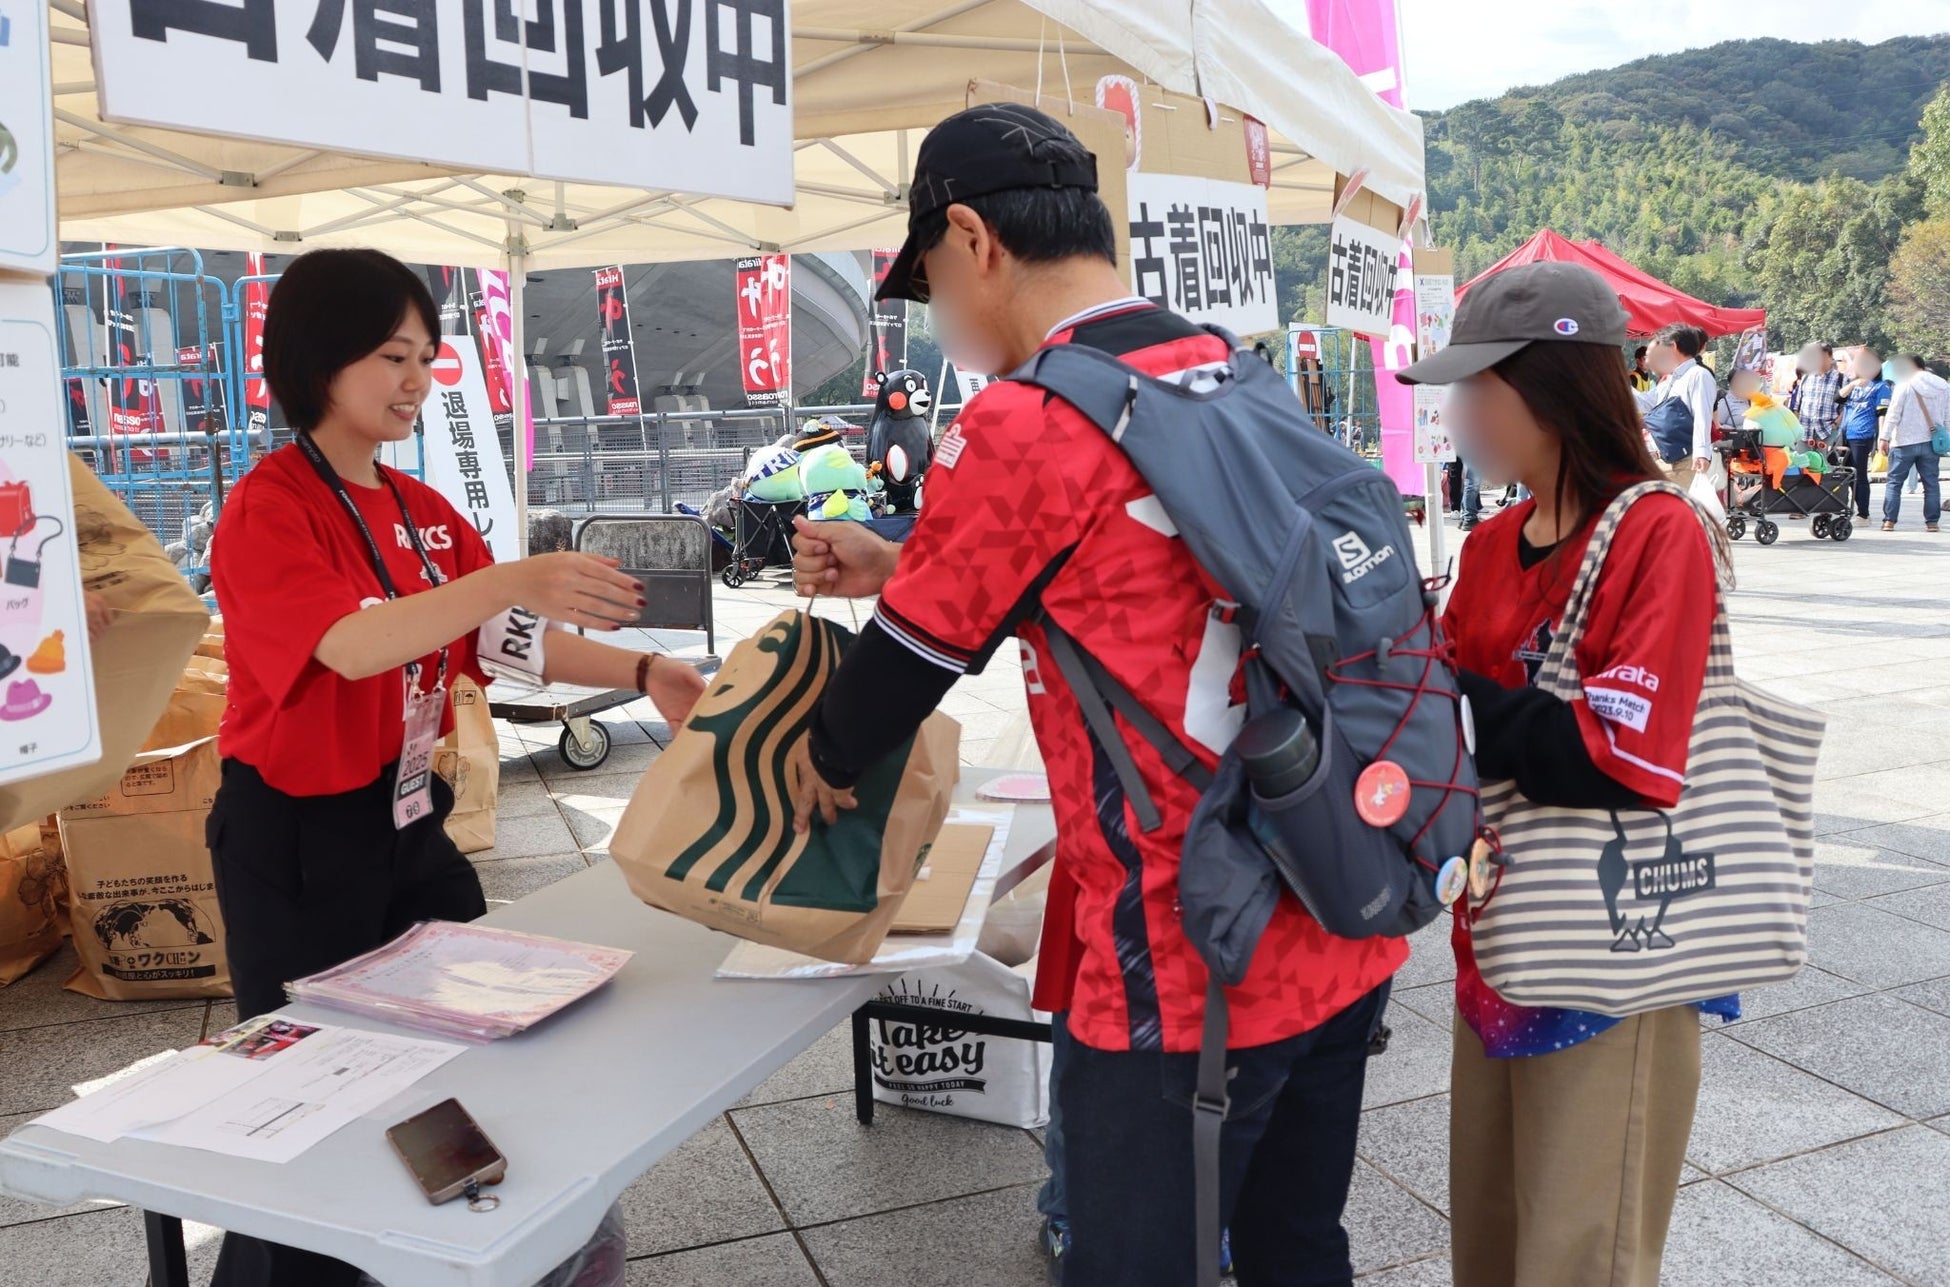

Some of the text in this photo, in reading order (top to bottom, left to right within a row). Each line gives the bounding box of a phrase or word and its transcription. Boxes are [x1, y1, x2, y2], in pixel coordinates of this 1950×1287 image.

[131, 0, 787, 147] 回収中
[1129, 202, 1272, 313] 古着回収中
[1331, 233, 1397, 319] 古着回収中
[1595, 664, 1660, 692] rata
[400, 774, 426, 796] GUEST
[1639, 857, 1709, 896] CHUMS
[910, 995, 920, 1005] TO
[920, 997, 927, 1006] A
[928, 997, 946, 1008] FINE
[947, 998, 973, 1013] START
[895, 1041, 986, 1076] easy
[941, 1081, 965, 1089] TODAY
